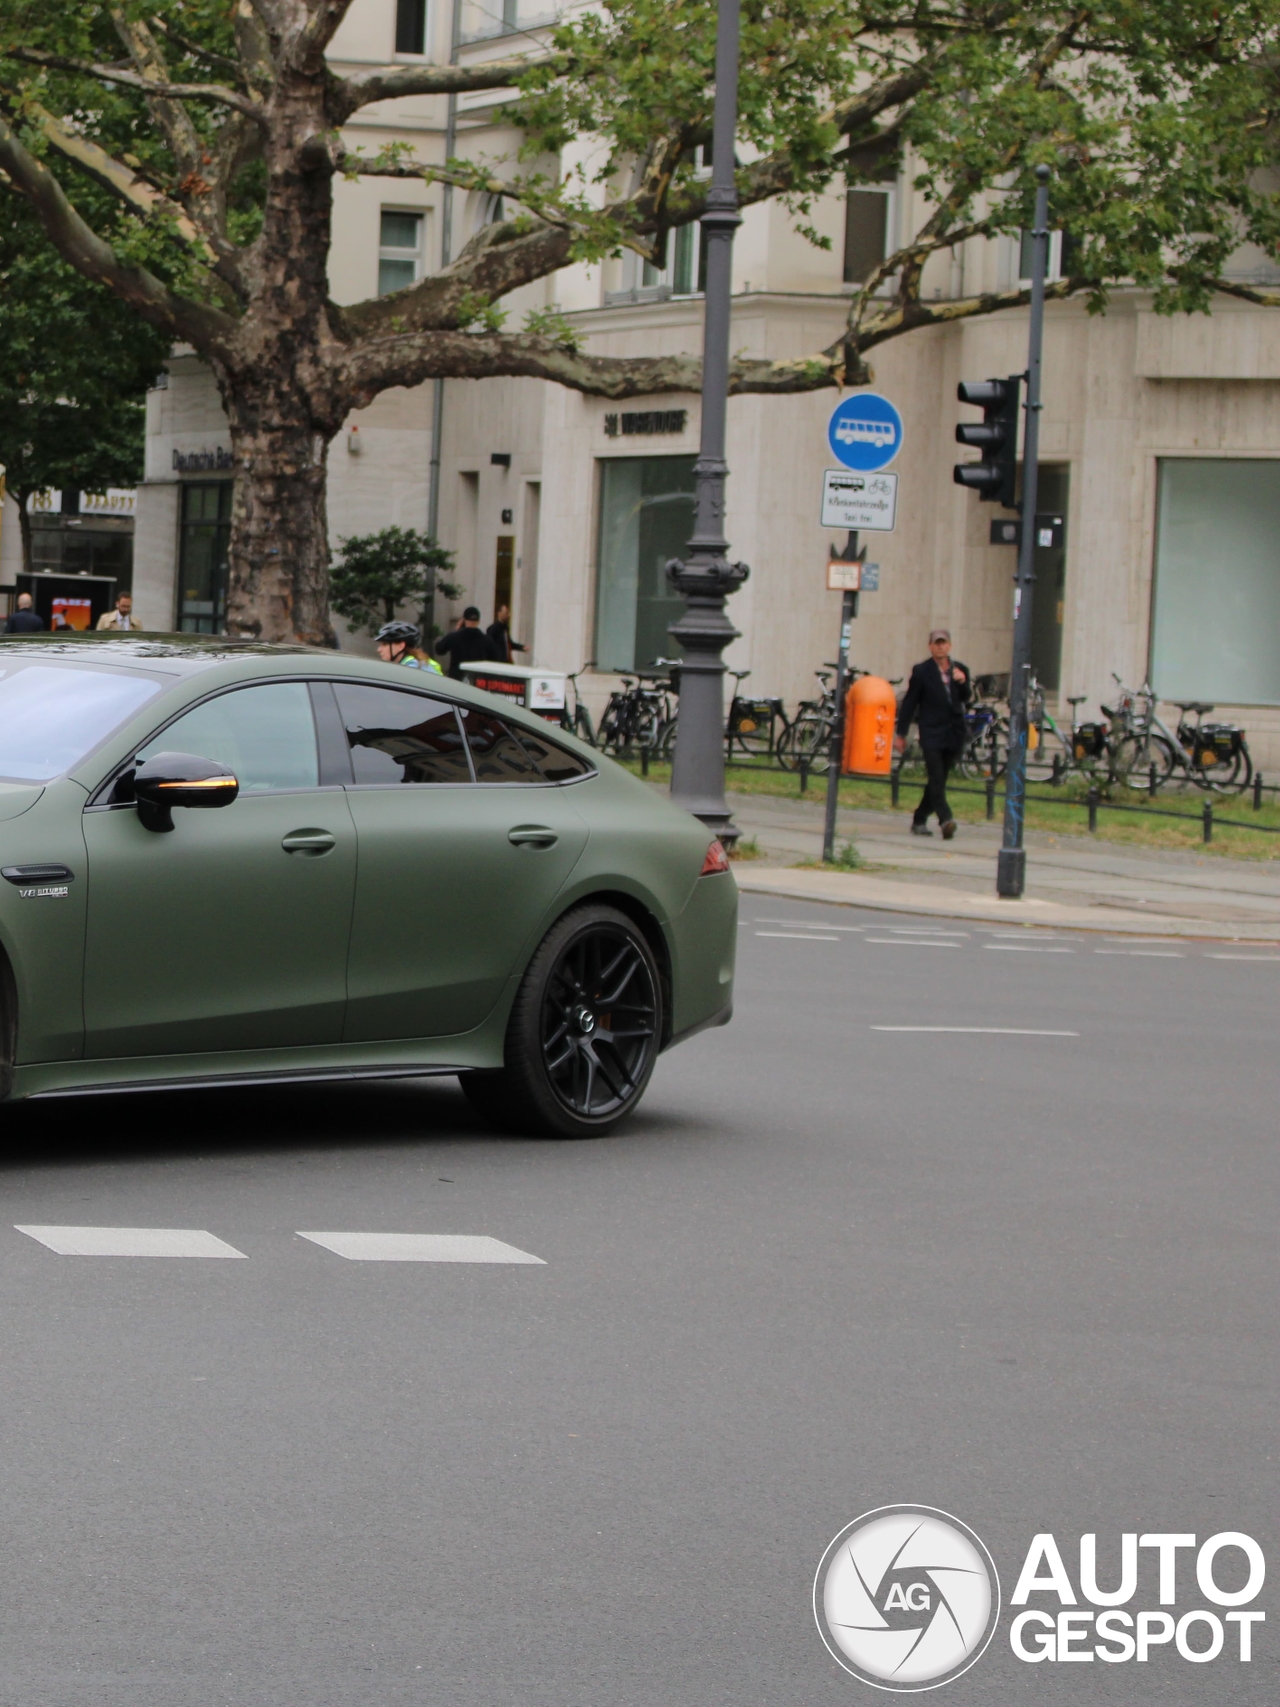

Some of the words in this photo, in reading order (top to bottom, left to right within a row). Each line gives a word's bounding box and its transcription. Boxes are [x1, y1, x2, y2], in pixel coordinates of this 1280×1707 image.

[85, 494, 135, 511] BEAUTY
[844, 512, 858, 522] Taxi
[860, 512, 873, 523] frei
[19, 889, 36, 898] V8
